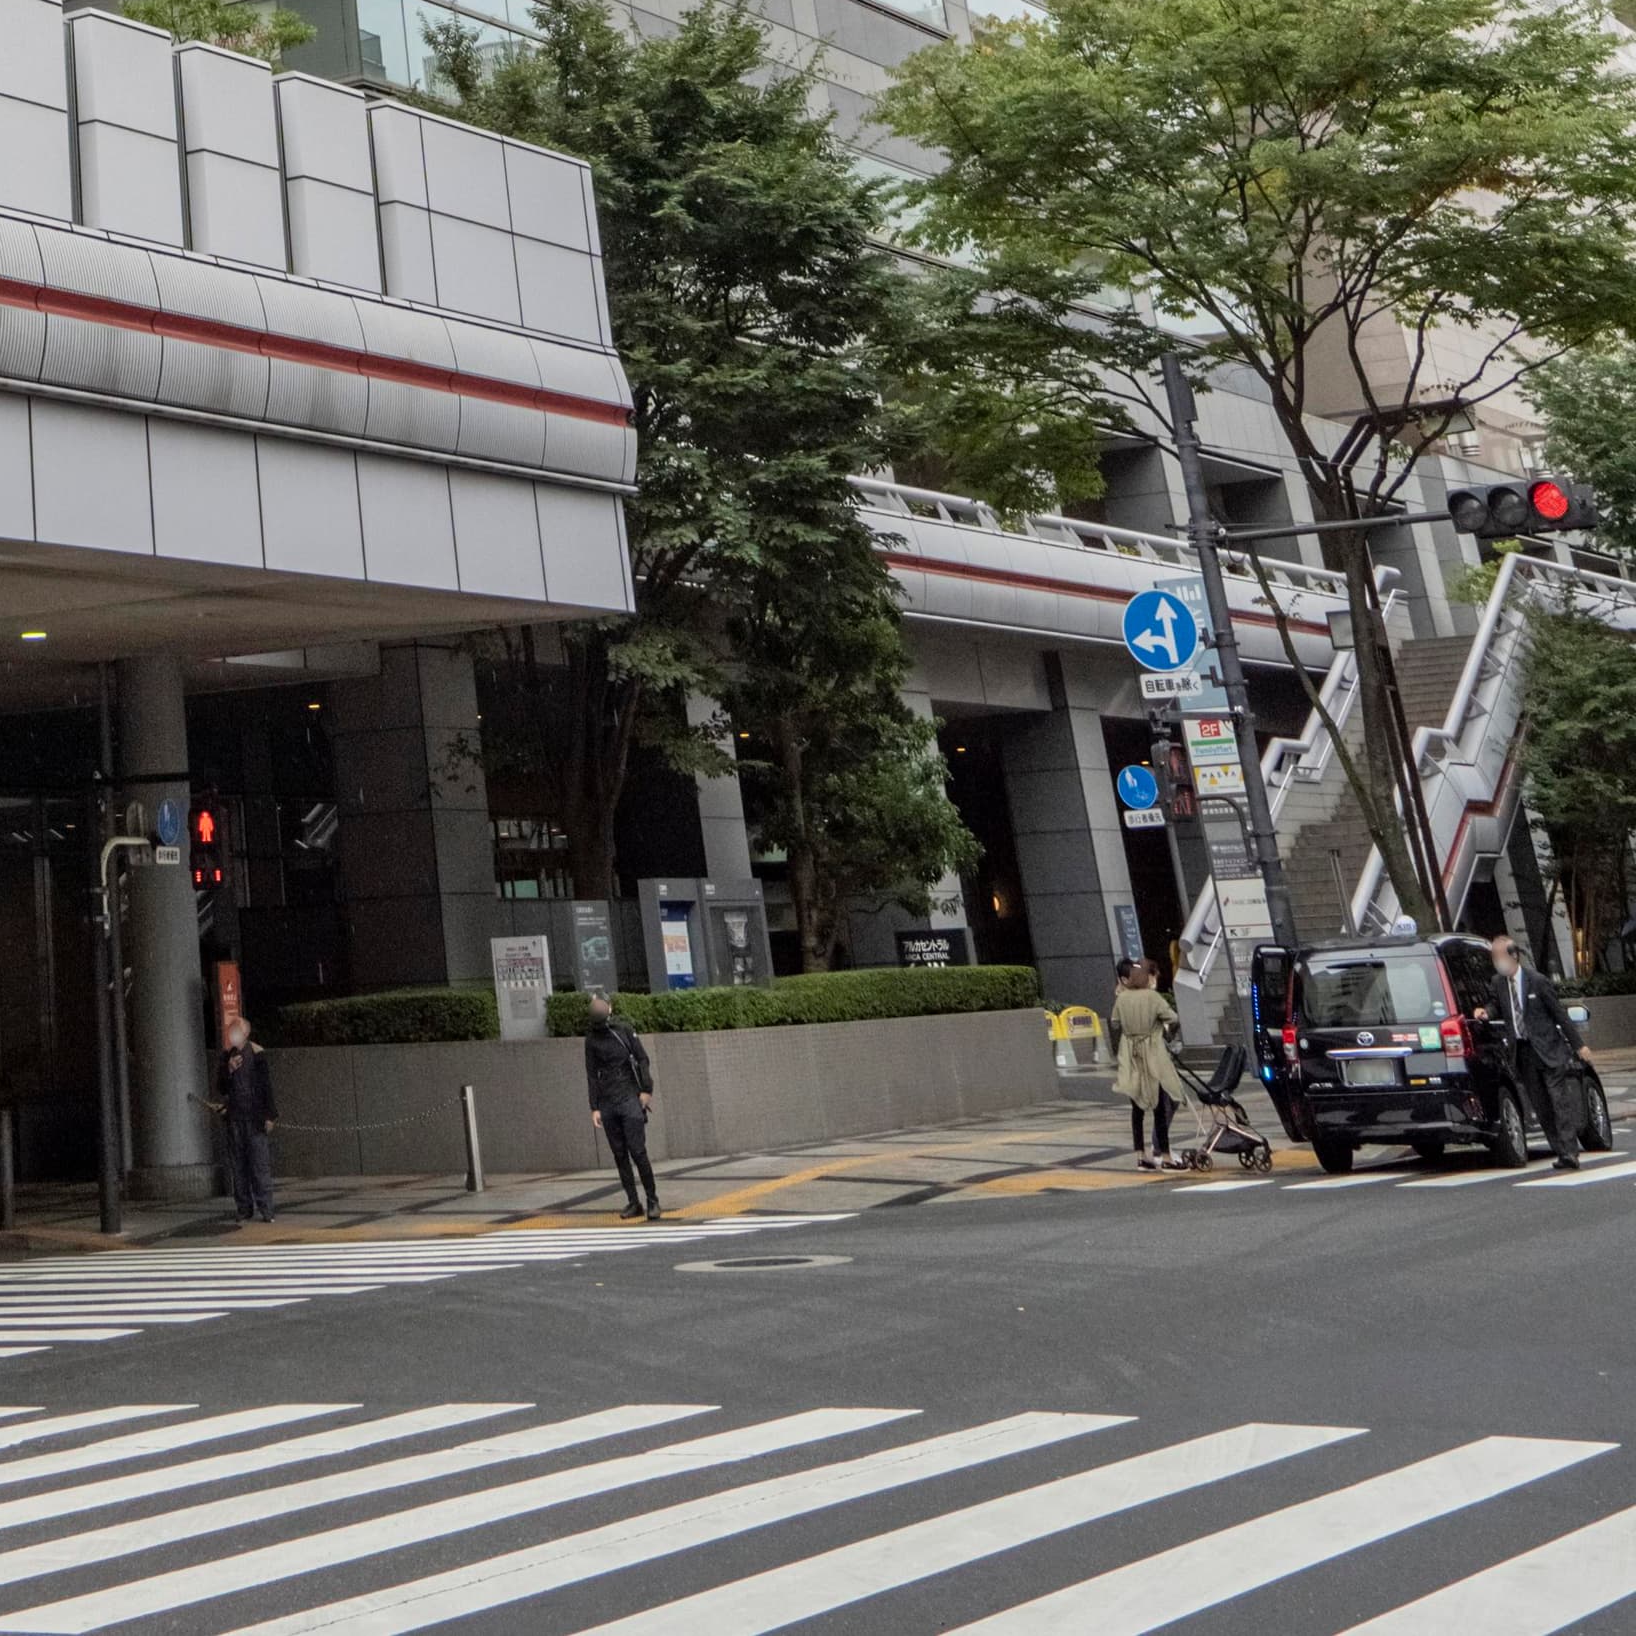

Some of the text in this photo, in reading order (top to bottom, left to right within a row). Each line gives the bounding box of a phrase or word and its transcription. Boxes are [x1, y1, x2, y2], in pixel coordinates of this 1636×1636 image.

[1144, 677, 1199, 693] 自転車を除く
[1201, 723, 1219, 737] 2F
[922, 952, 951, 961] CENTRAL
